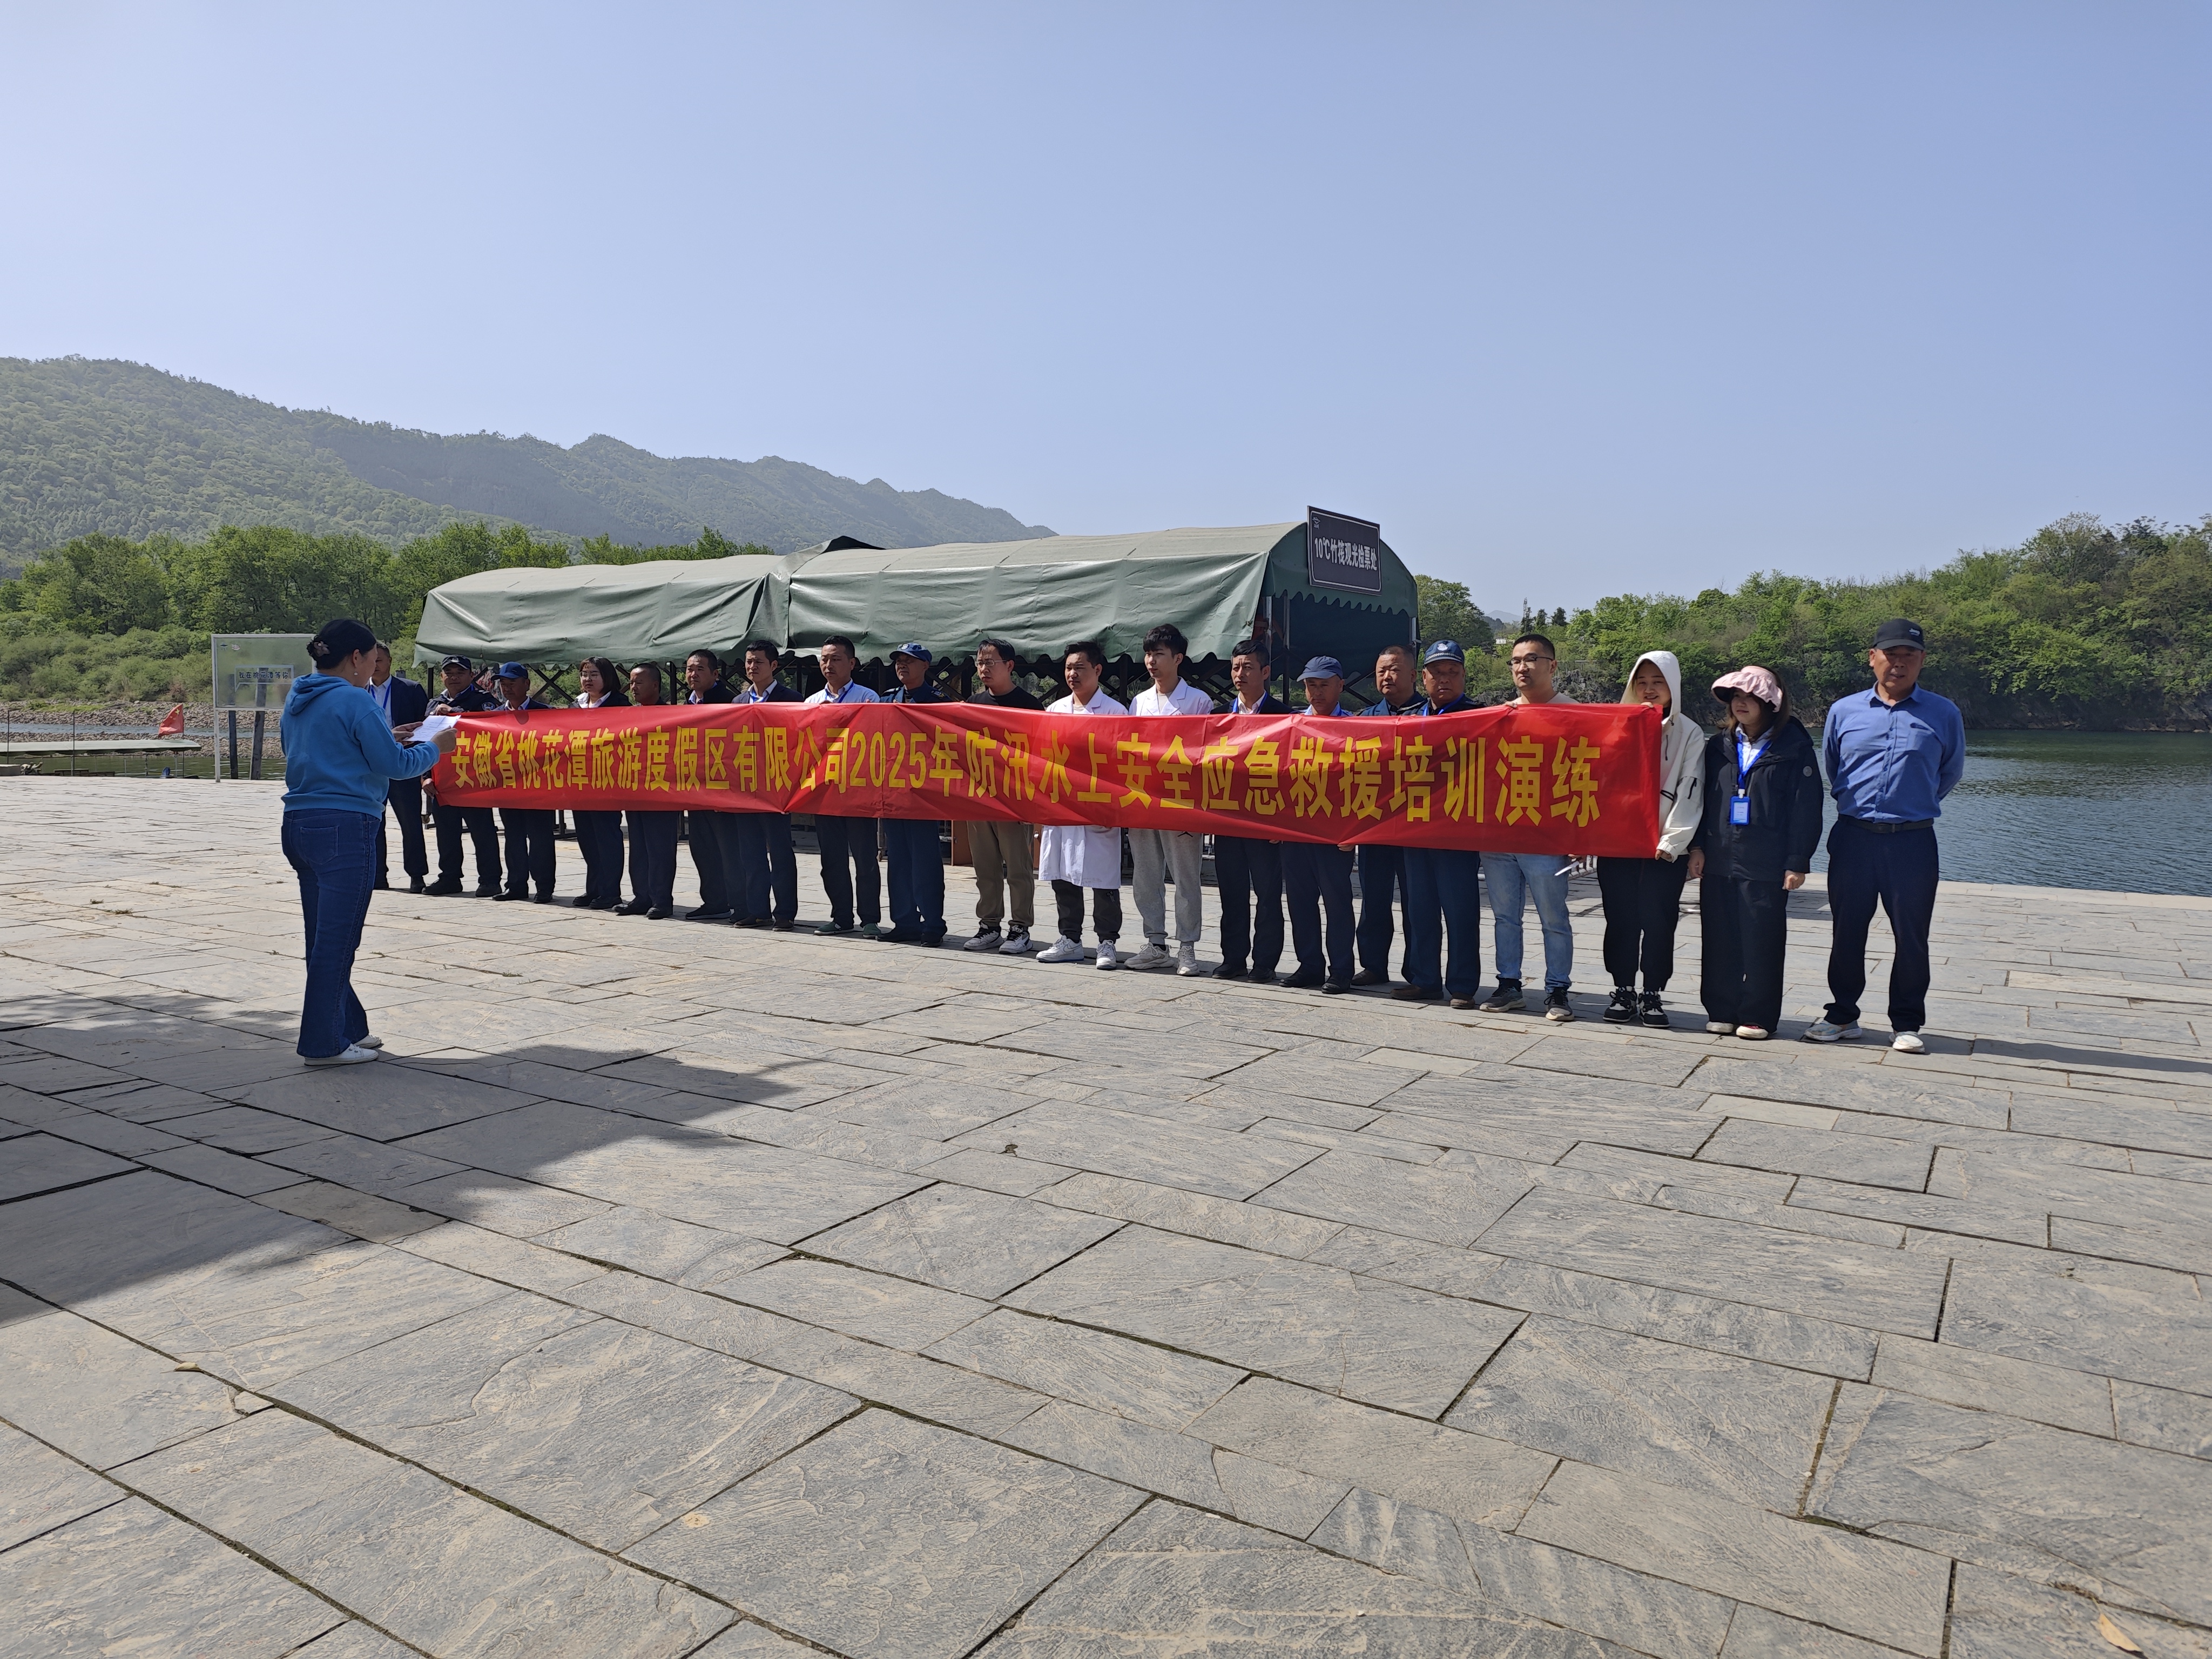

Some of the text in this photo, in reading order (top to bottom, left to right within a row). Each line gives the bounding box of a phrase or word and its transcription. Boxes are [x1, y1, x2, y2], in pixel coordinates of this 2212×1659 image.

[238, 671, 289, 679] 我在桃花潭等你
[451, 724, 1601, 827] 安徽省桃花潭旅游度假区有限公司2025年防汛水上安全应急救援培训演练
